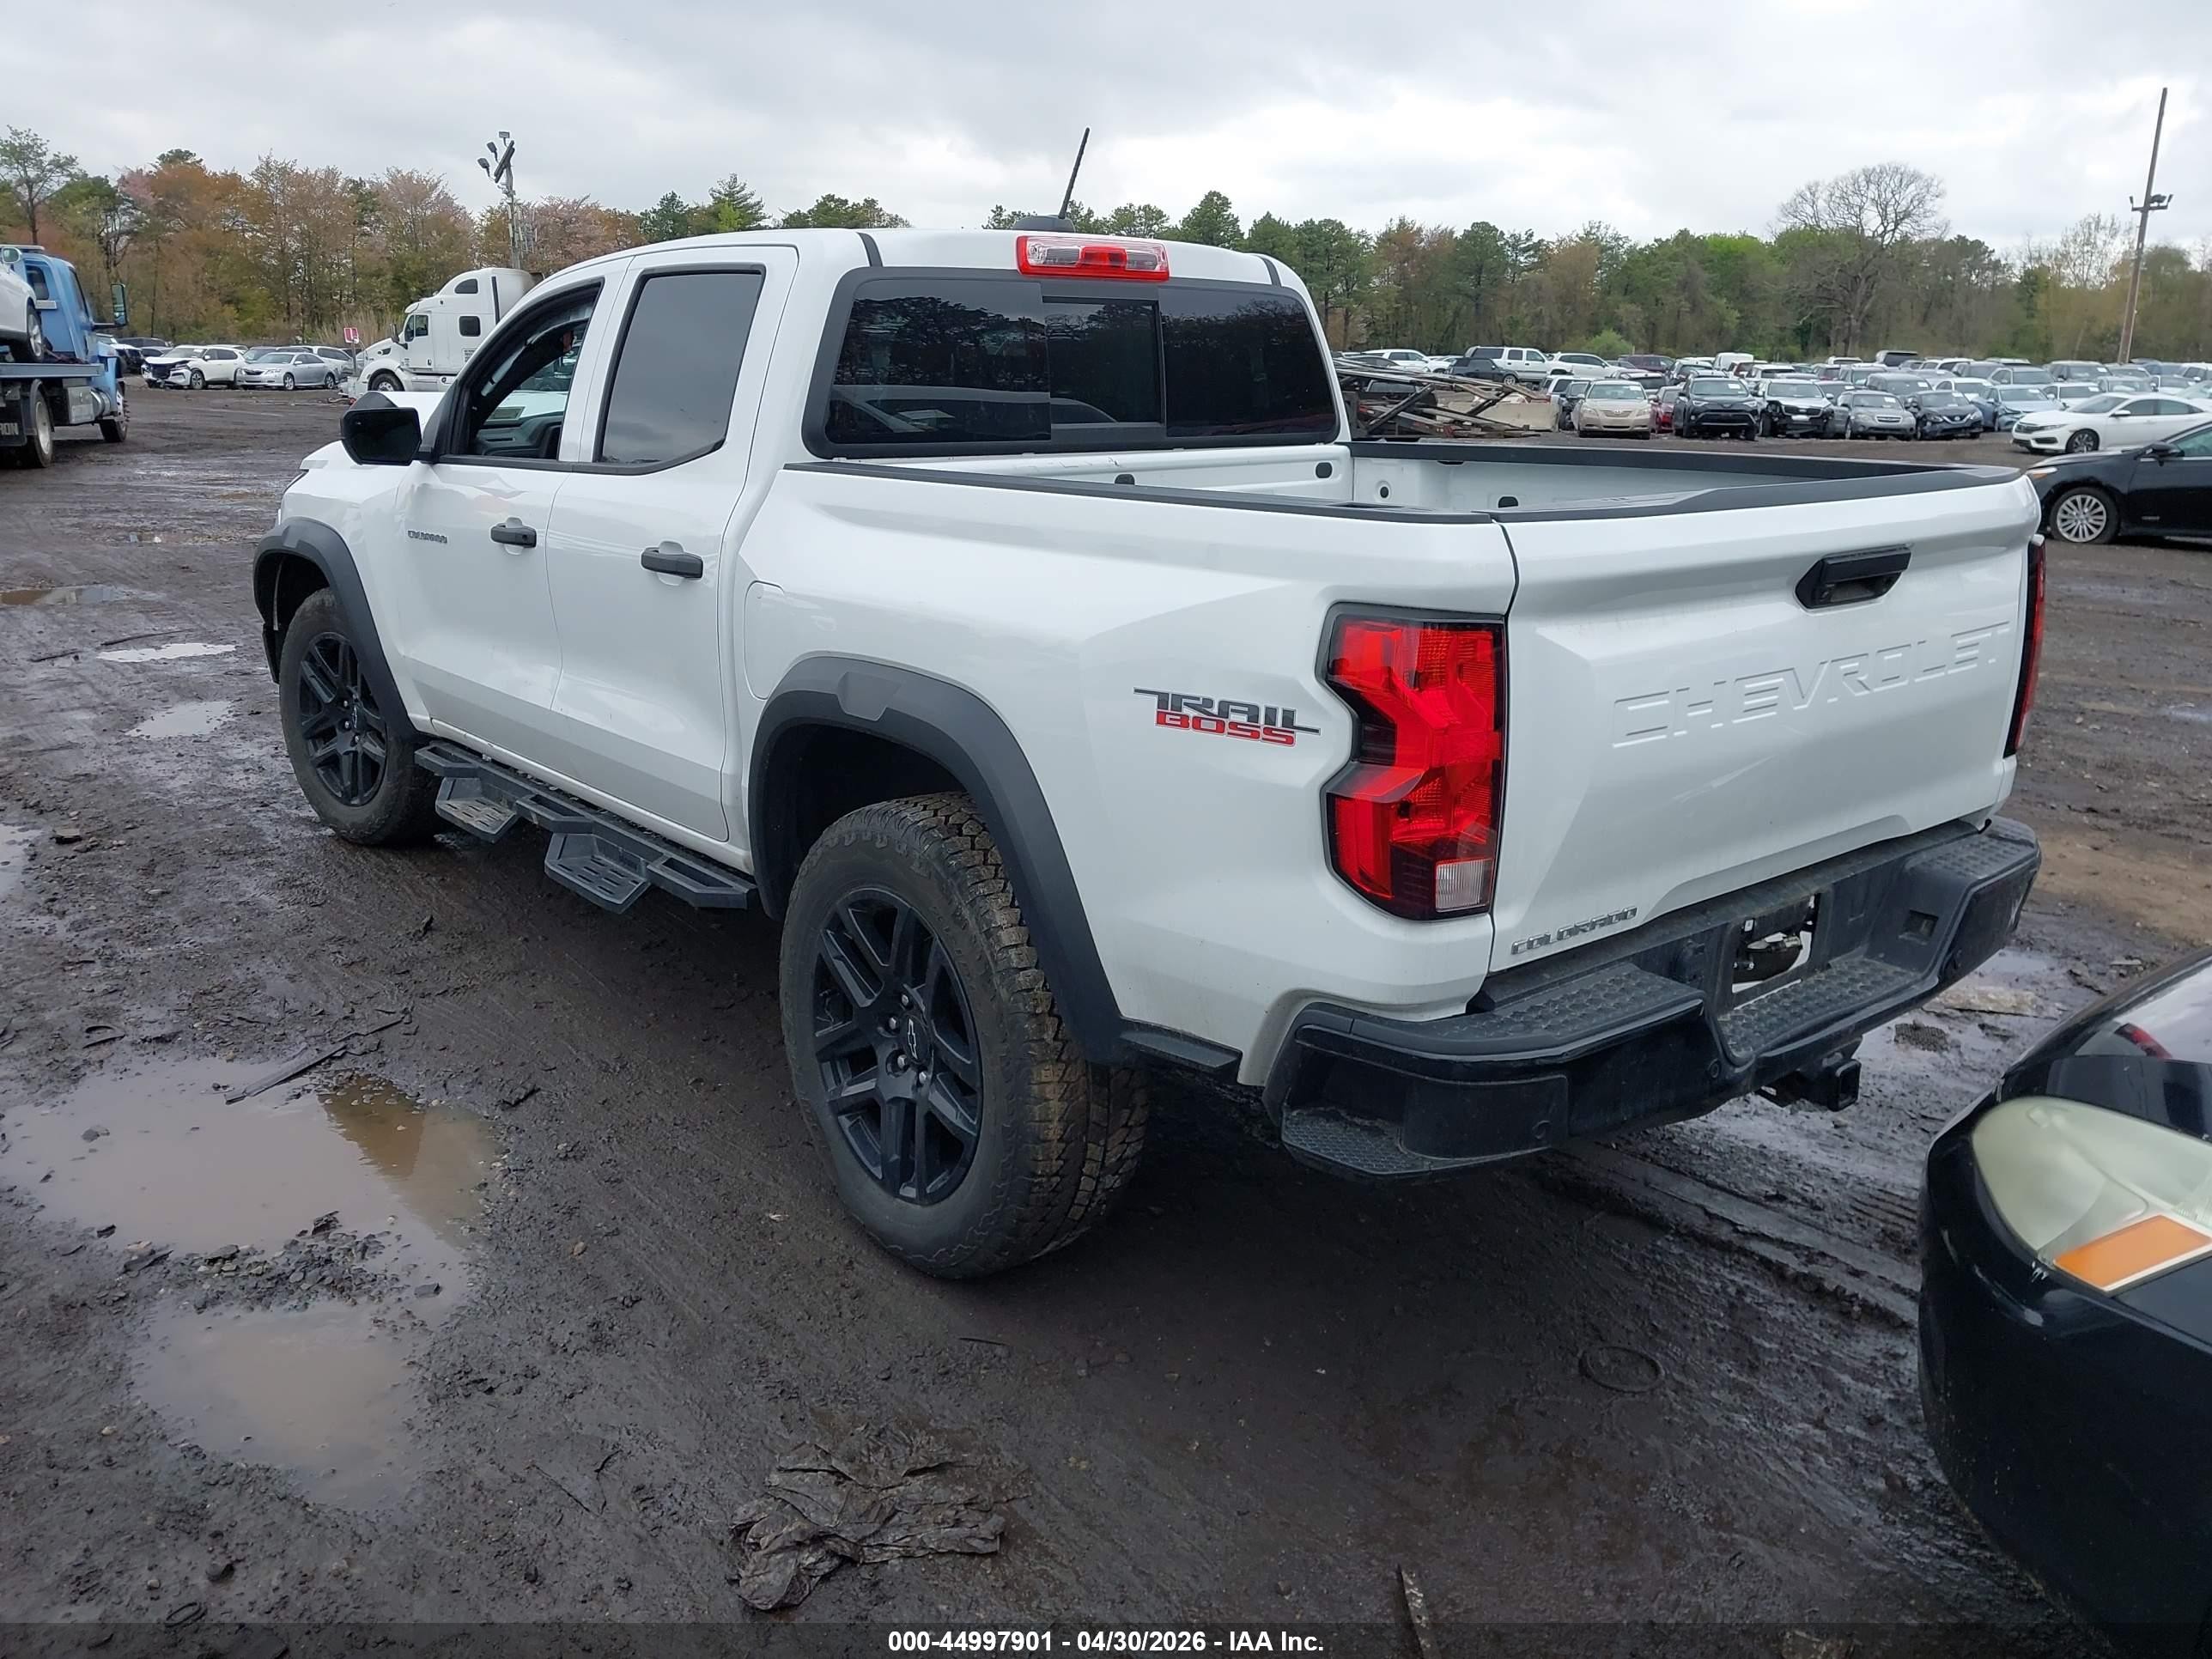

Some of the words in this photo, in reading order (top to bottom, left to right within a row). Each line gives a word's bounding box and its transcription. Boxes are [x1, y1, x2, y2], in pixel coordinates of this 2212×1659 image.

[1612, 621, 2010, 748] CHEVROLET
[1133, 687, 1321, 735] TRAIL
[1155, 711, 1296, 747] BOSS
[1511, 906, 1638, 954] COLORADO
